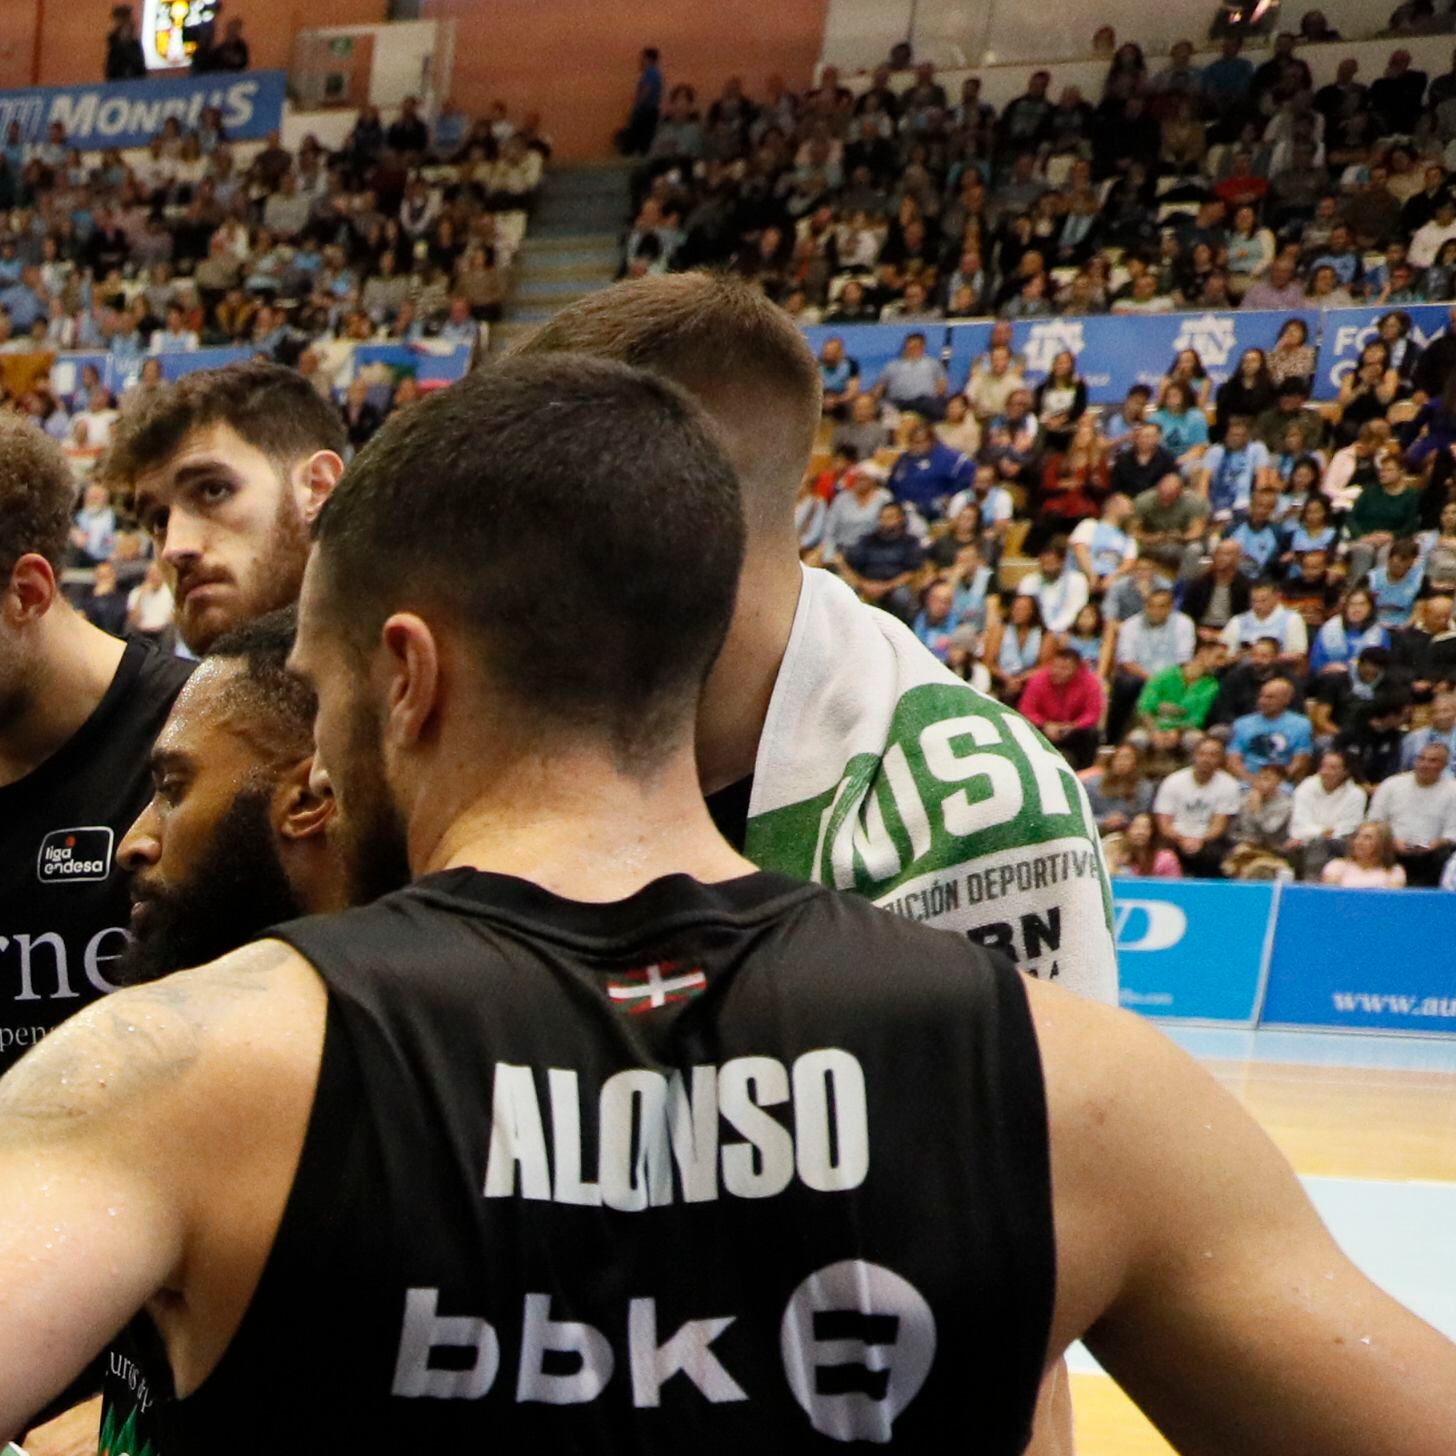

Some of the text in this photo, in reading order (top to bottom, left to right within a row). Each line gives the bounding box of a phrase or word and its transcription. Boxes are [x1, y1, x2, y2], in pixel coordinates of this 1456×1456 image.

[47, 80, 261, 138] MONS
[44, 858, 104, 875] endesa
[45, 846, 72, 862] liga
[967, 849, 1100, 907] DEPORTIVA
[885, 878, 960, 921] ICIÓN
[967, 905, 1062, 964] RN
[484, 1047, 870, 1212] ALONSO
[390, 1286, 750, 1408] bbk
